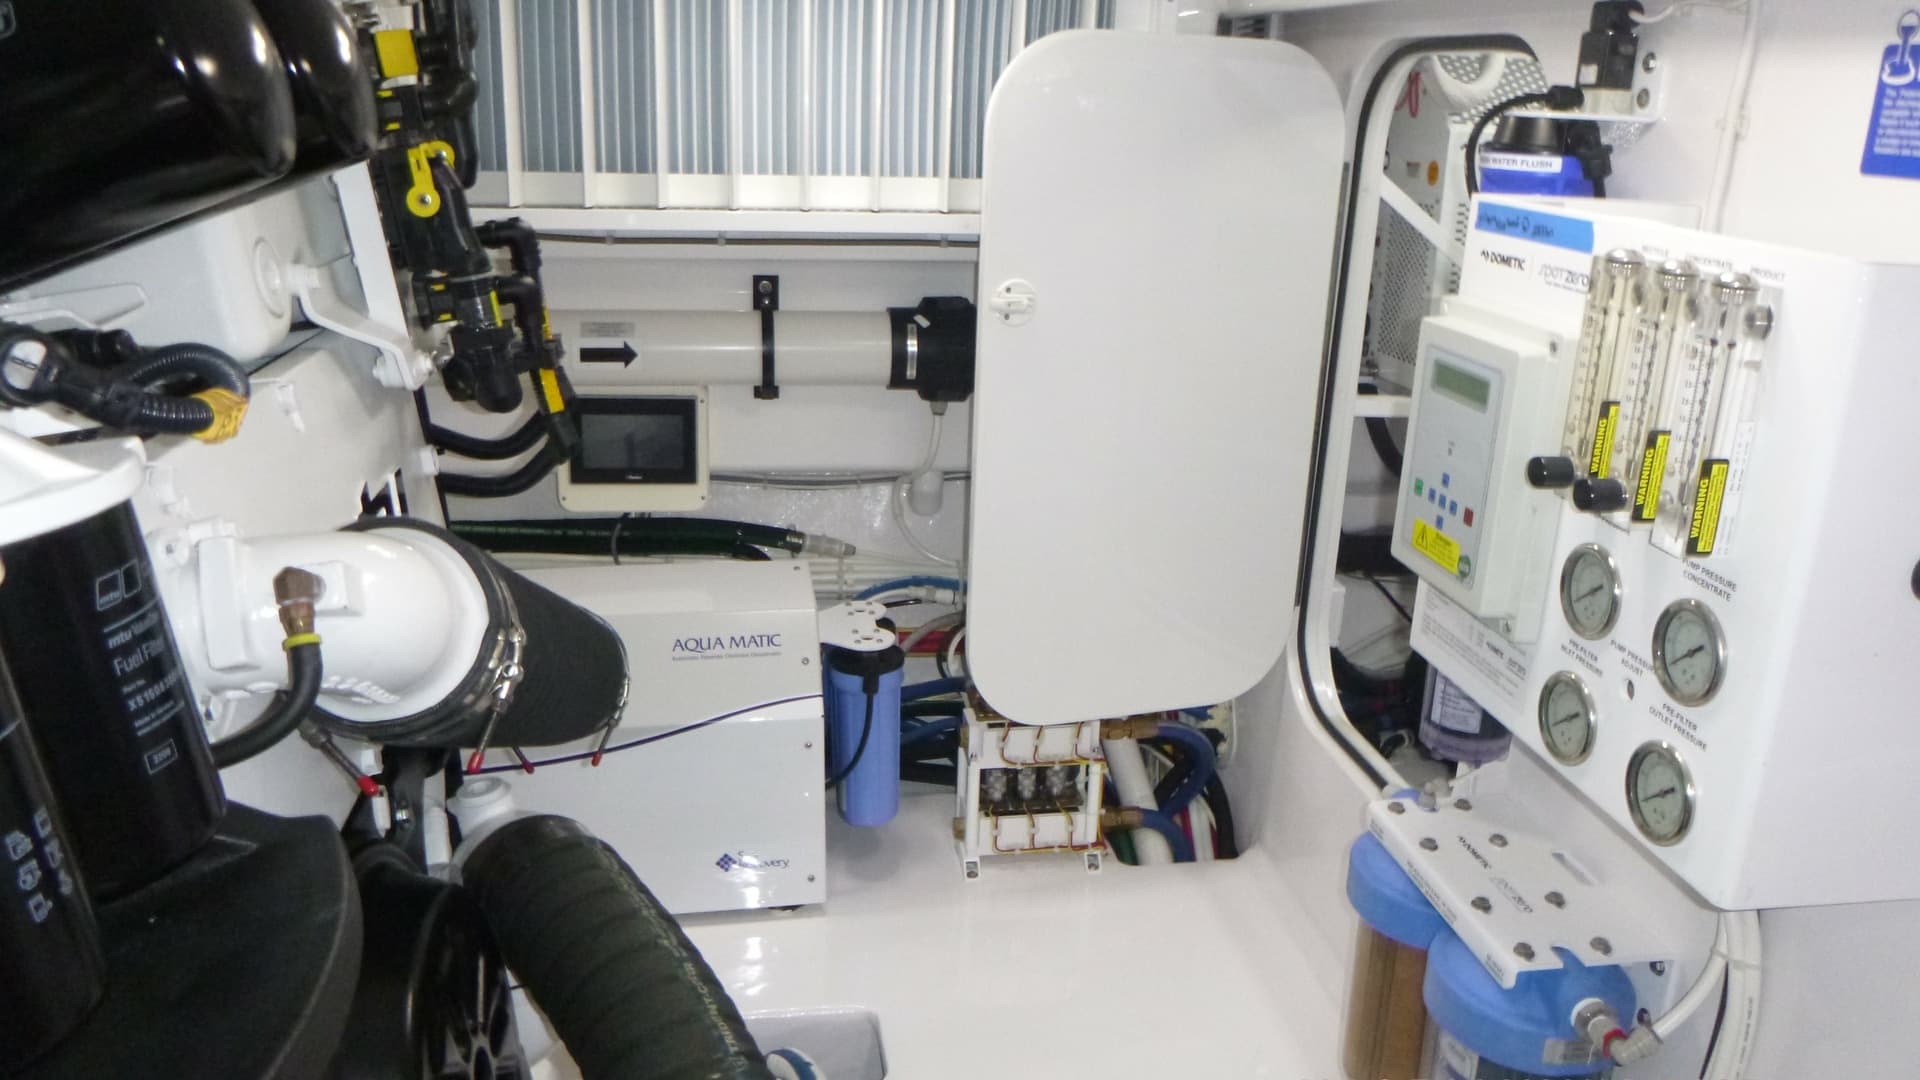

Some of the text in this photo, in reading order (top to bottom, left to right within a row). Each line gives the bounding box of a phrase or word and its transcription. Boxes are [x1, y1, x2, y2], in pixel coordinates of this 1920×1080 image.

[1520, 159, 1553, 169] FLUSH
[1490, 253, 1525, 271] DOMETIC
[1591, 419, 1608, 474] WARNING
[1636, 448, 1655, 506] WARNING
[1690, 479, 1709, 539] WARNING
[1683, 557, 1737, 592] PUMP PRESSURE
[1683, 570, 1731, 602] CONCENTRATE
[672, 634, 782, 653] AQUA MATIC
[113, 647, 144, 677] Fuel
[1621, 658, 1644, 677] ADJUST
[1649, 706, 1707, 752] OUTLET PRESSURE
